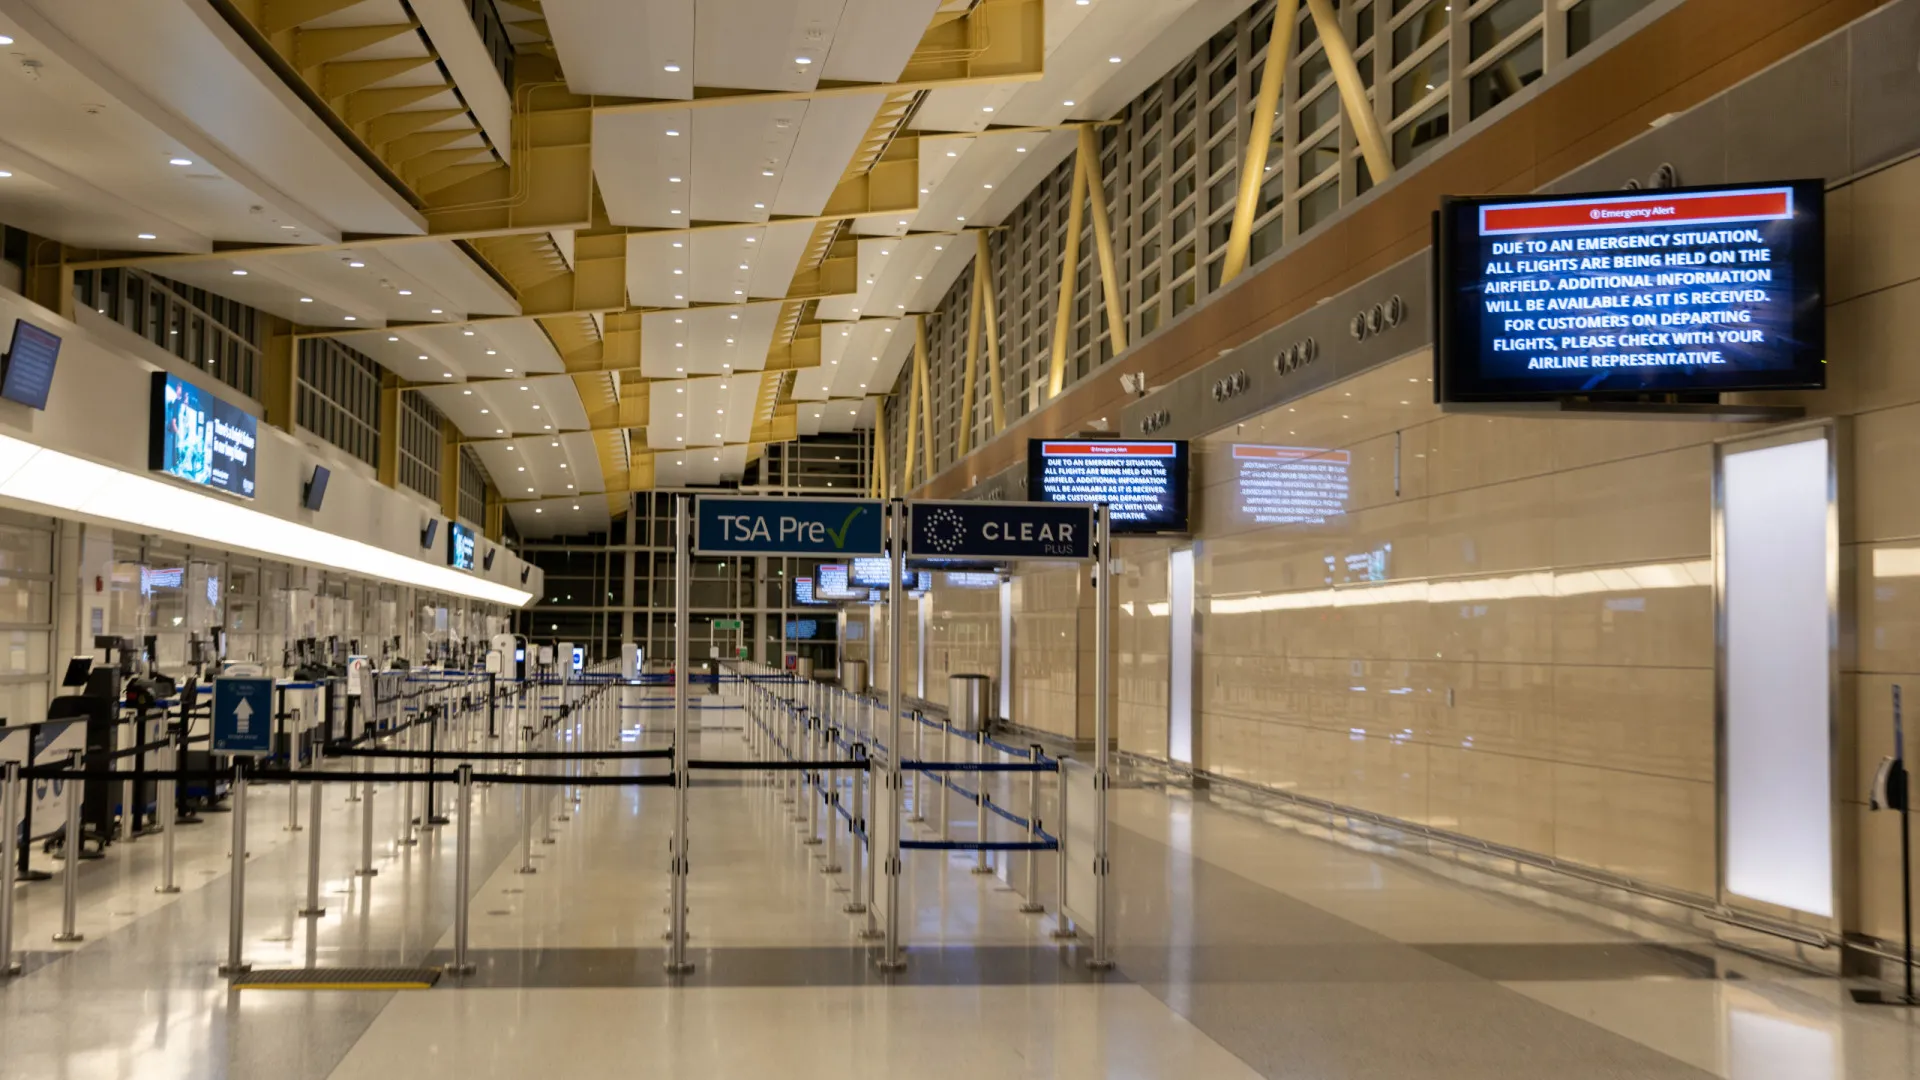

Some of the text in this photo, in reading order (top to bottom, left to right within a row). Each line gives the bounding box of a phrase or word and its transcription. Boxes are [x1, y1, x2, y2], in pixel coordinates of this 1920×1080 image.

[1601, 206, 1676, 219] Emergency Alert
[1492, 229, 1763, 255] DUE TO AN EMERGENCY SITUATION,
[1485, 248, 1770, 275] ALL FLIGHTS ARE BEING HELD ON THE
[1484, 269, 1771, 294] AIRFIELD. ADDITIONAL INFORMATION
[1485, 289, 1771, 313] WILL BE AVAILABLE AS IT IS RECEIVED.
[1504, 310, 1751, 332] FOR CUSTOMERS ON DEPARTING
[1493, 330, 1764, 351] FLIGHTS, PLEASE CHECK WITH YOUR
[1527, 351, 1726, 370] AIRLINE REPRESENTATIVE.
[1045, 467, 1058, 475] ALL
[1058, 467, 1086, 475] FLIGHTS
[1085, 459, 1125, 467] EMERGENCY
[1125, 459, 1164, 467] SITUATION,
[1044, 476, 1075, 484] AIRFIELD.
[1076, 476, 1117, 484] ADDITIONAL
[1044, 485, 1061, 493] WILL
[1062, 485, 1071, 493] BE
[1133, 486, 1167, 494] RECEIVED.
[1107, 494, 1119, 502] ON
[1124, 503, 1143, 511] WITH
[1143, 503, 1163, 511] YOUR
[717, 515, 825, 543] TSA Pre
[982, 521, 1074, 542] CLEAR
[1044, 544, 1074, 554] PLUS
